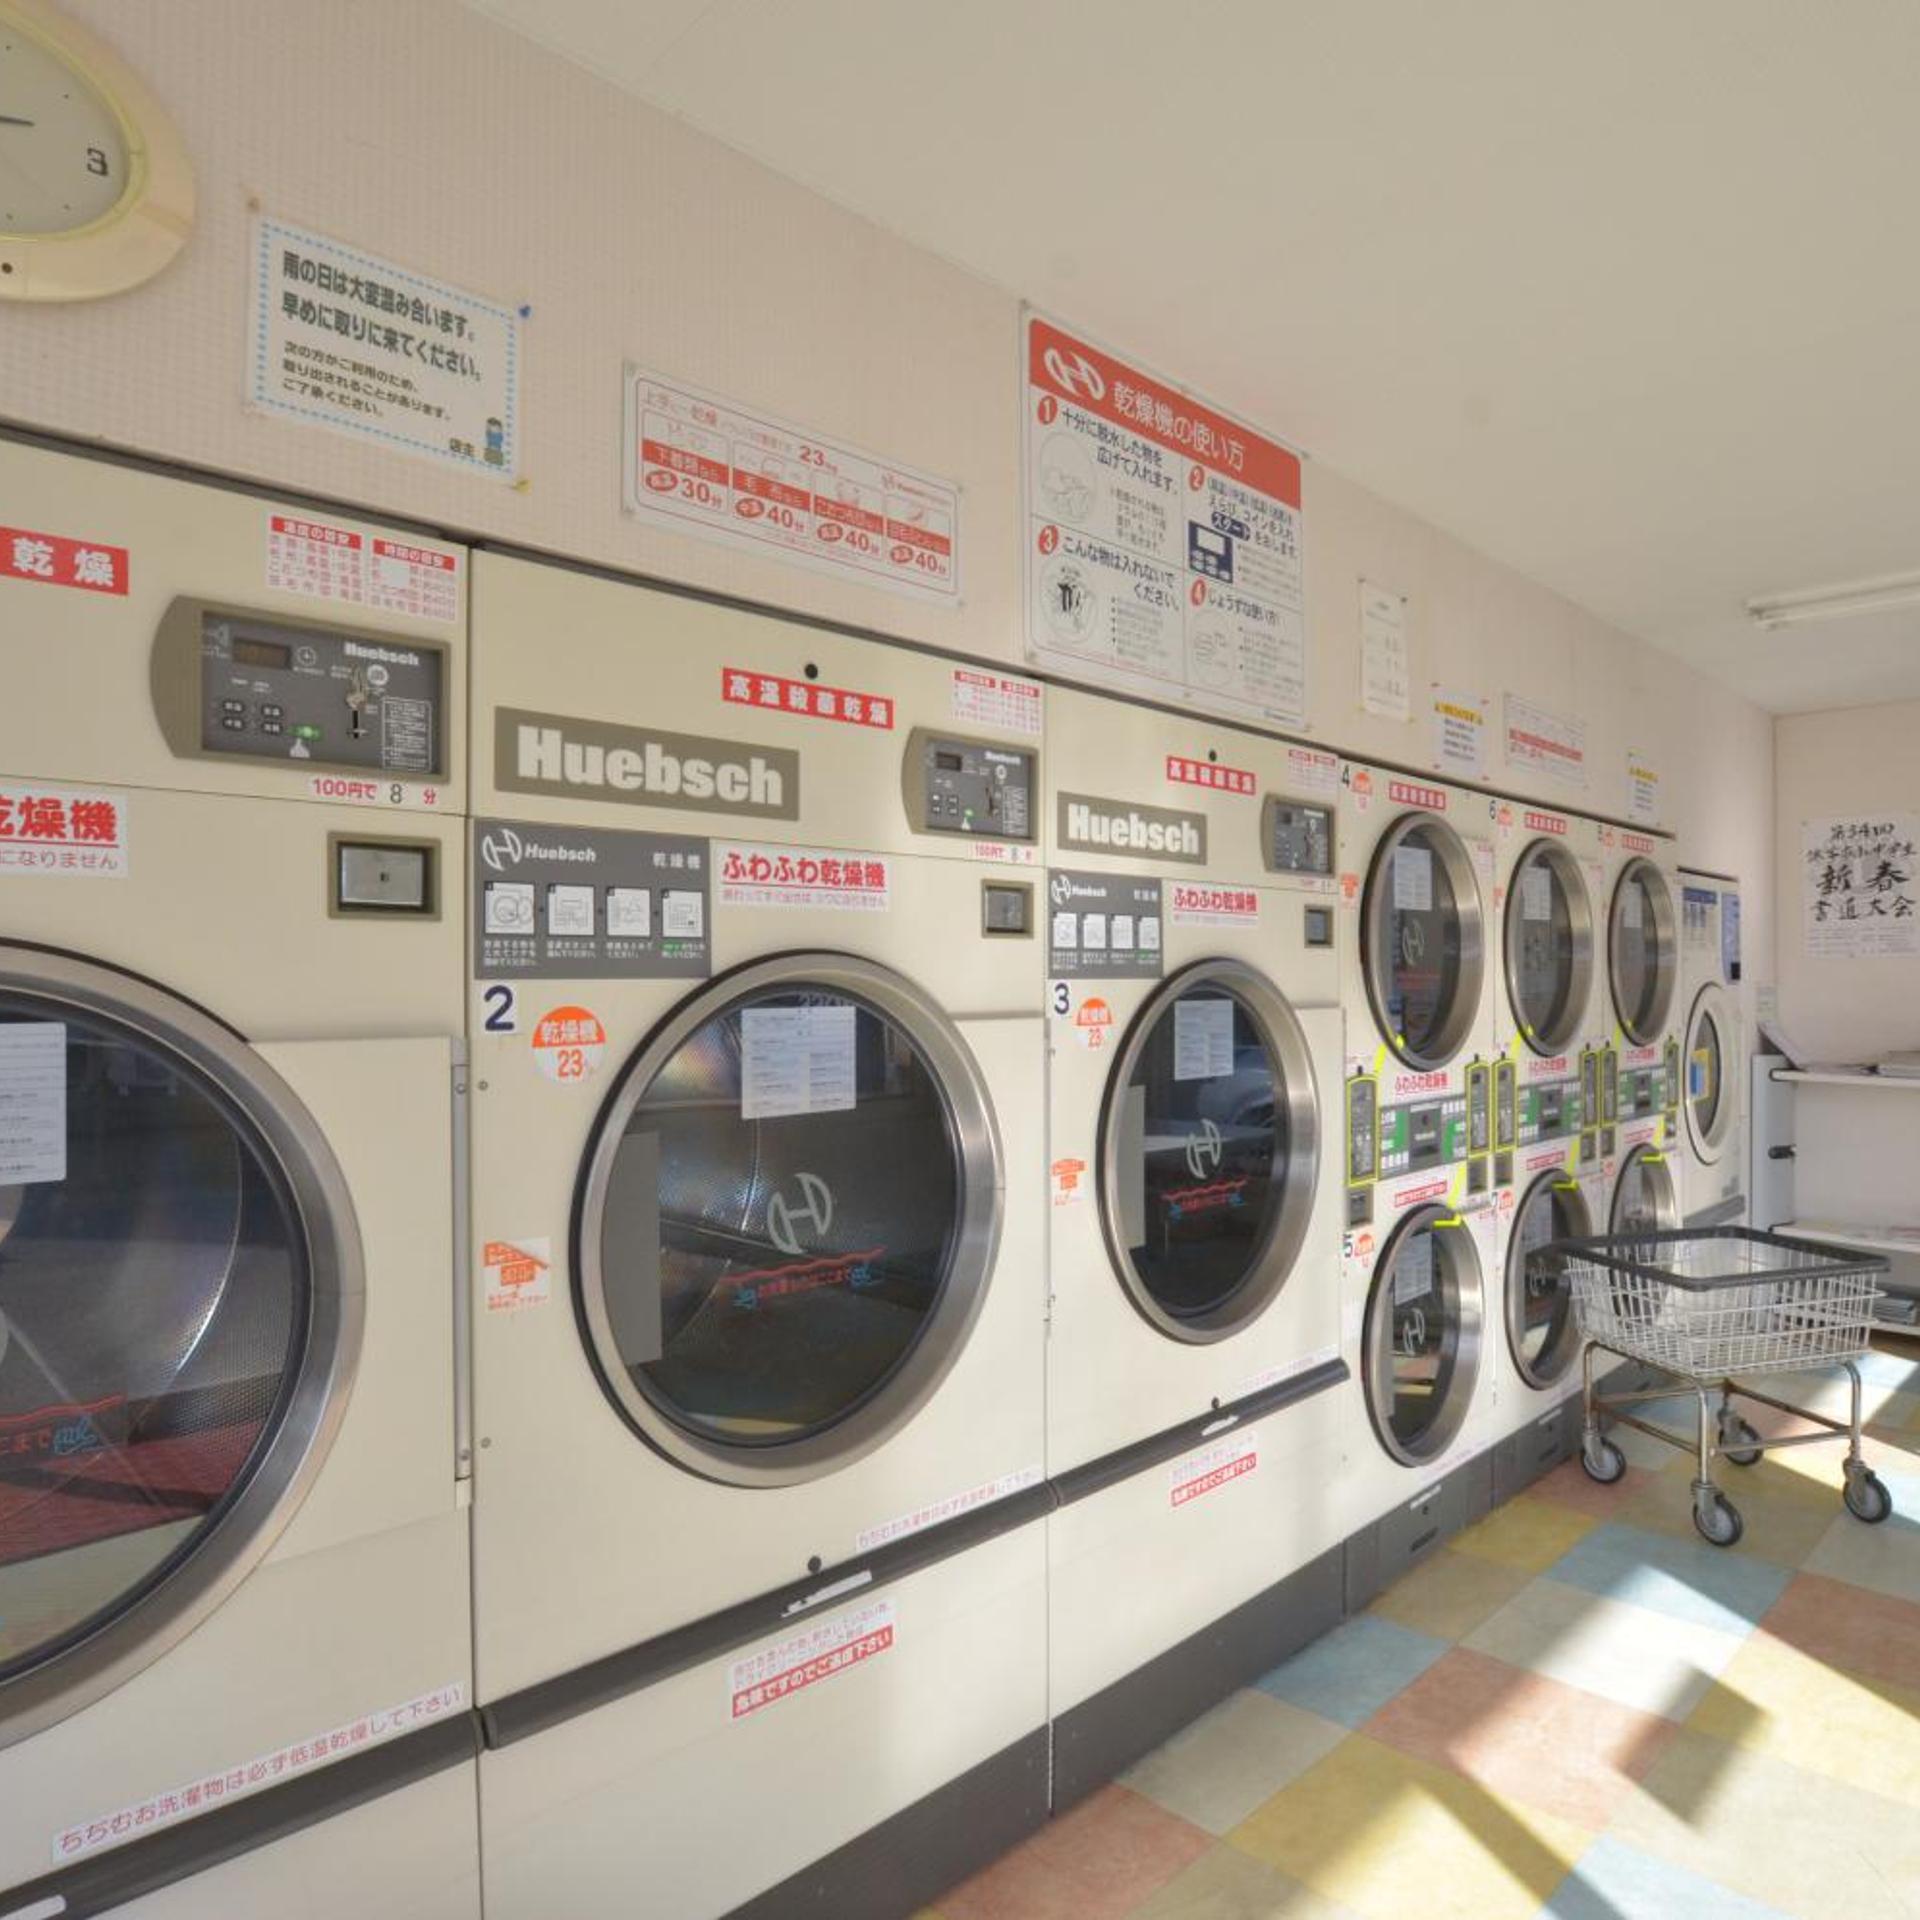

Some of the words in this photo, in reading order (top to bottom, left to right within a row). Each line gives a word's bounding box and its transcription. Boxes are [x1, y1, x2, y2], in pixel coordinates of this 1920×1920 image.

[86, 147, 109, 176] 3
[282, 291, 481, 382] 早めに取りに来てください。
[1112, 380, 1246, 473] 乾燥機の使い方
[344, 641, 420, 666] Huebsch
[517, 724, 783, 806] Huebsch
[313, 778, 377, 800] 100円で
[390, 783, 404, 804] 8
[1067, 802, 1200, 855] Huebsch
[524, 843, 597, 863] Huebsch
[722, 852, 886, 887] ふわふわ乾燥機
[484, 984, 515, 1031] 2
[1053, 983, 1070, 1015] 3
[557, 1049, 584, 1078] 23
